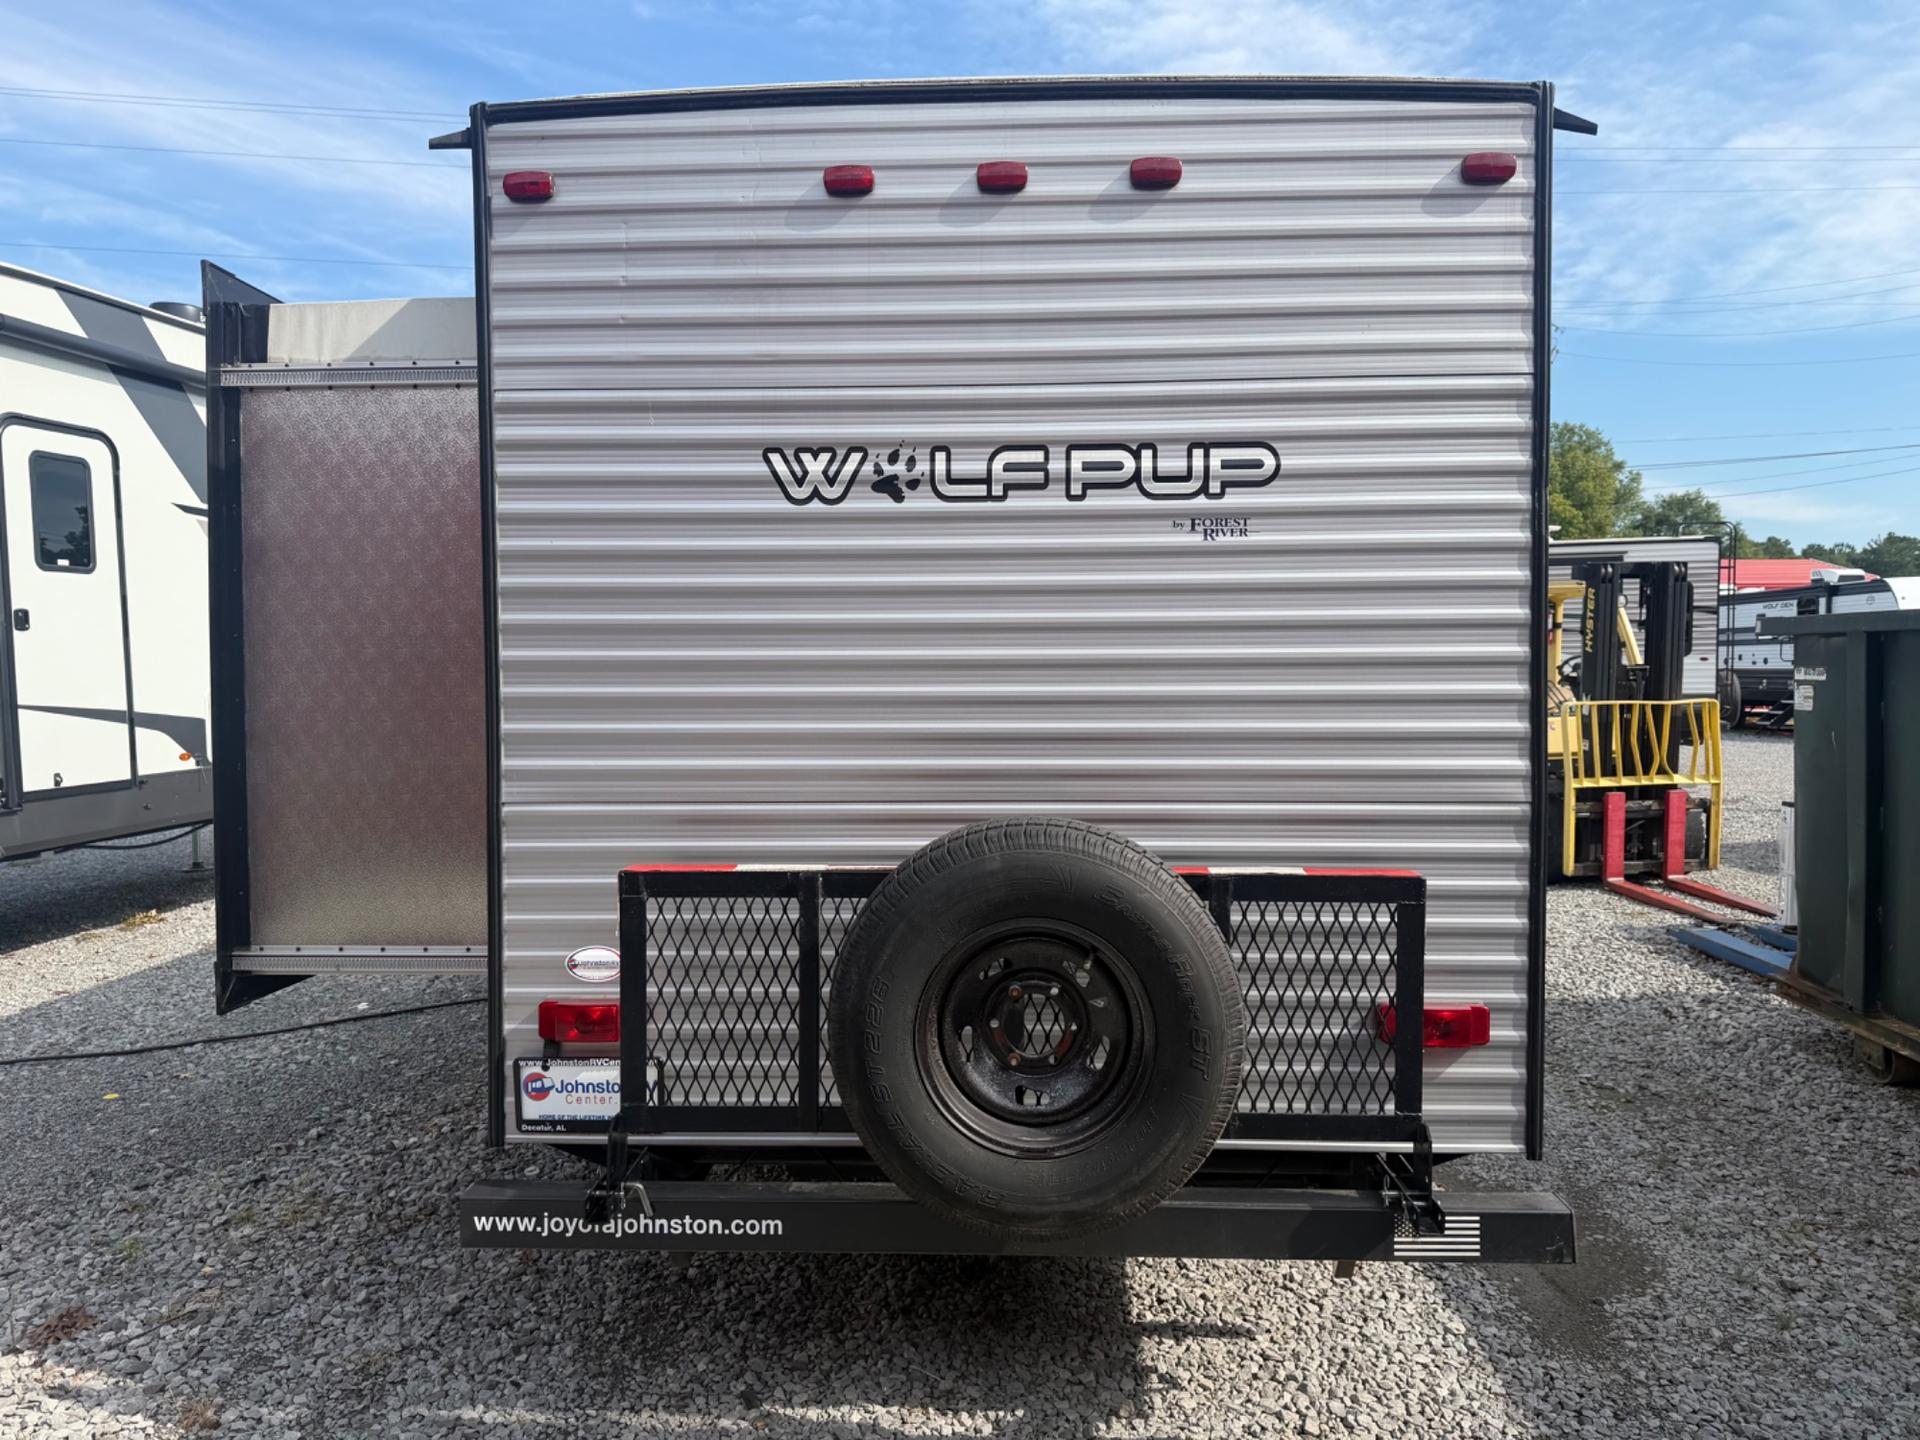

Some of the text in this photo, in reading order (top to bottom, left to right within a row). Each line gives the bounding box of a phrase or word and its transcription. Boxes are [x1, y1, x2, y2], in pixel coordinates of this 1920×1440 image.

[1066, 442, 1281, 501] PUP
[1173, 517, 1251, 532] by FOREST
[1203, 527, 1248, 541] RIVER
[1584, 587, 1596, 653] HYSTER
[555, 1080, 621, 1094] Johnsto
